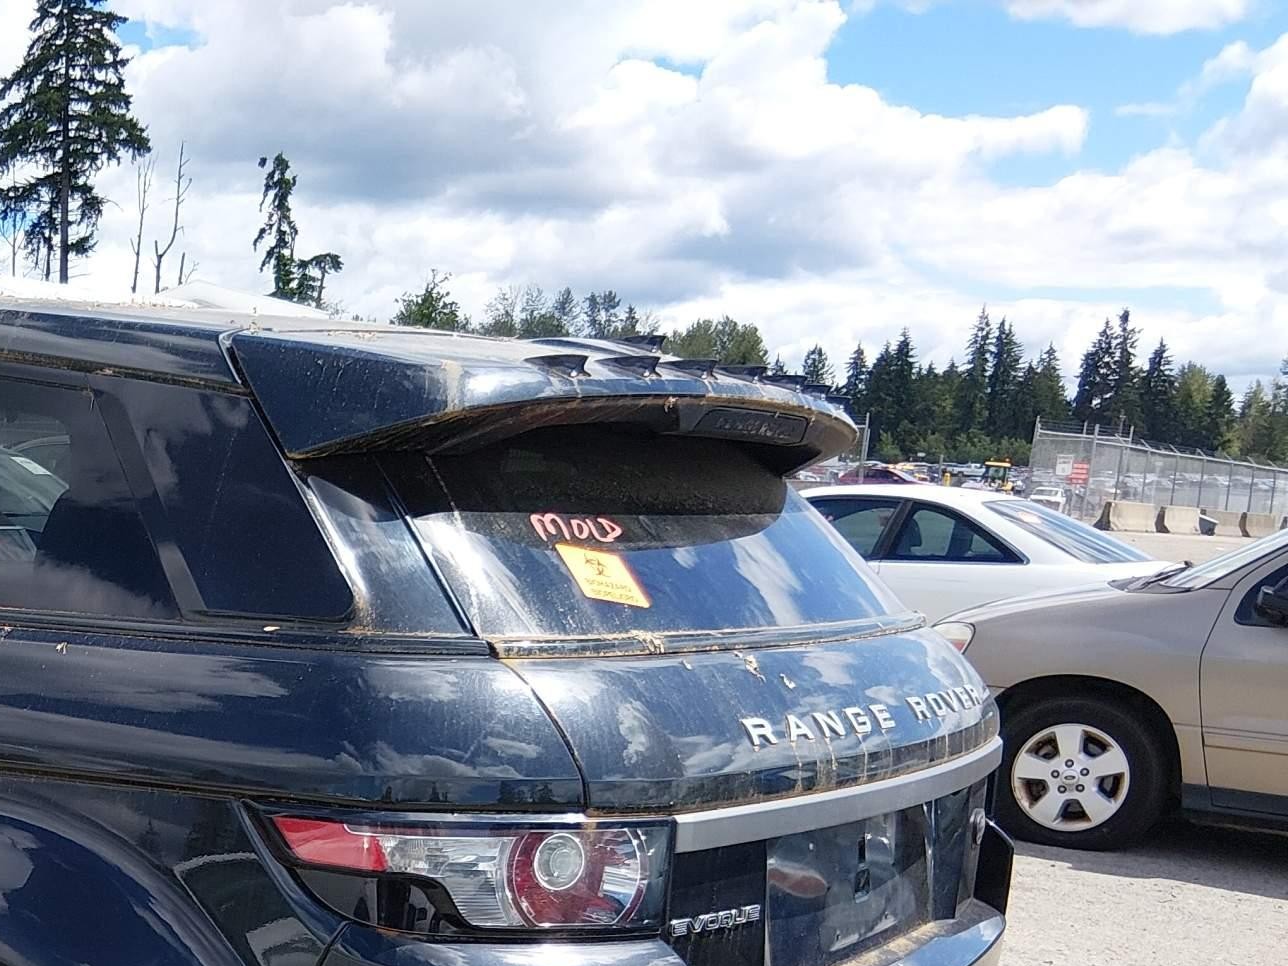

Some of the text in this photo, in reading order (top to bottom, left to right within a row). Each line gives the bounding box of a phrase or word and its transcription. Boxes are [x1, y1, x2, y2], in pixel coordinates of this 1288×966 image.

[530, 512, 623, 542] MOLD
[740, 685, 985, 747] RANGE ROVER
[671, 904, 761, 937] EVOQUE
